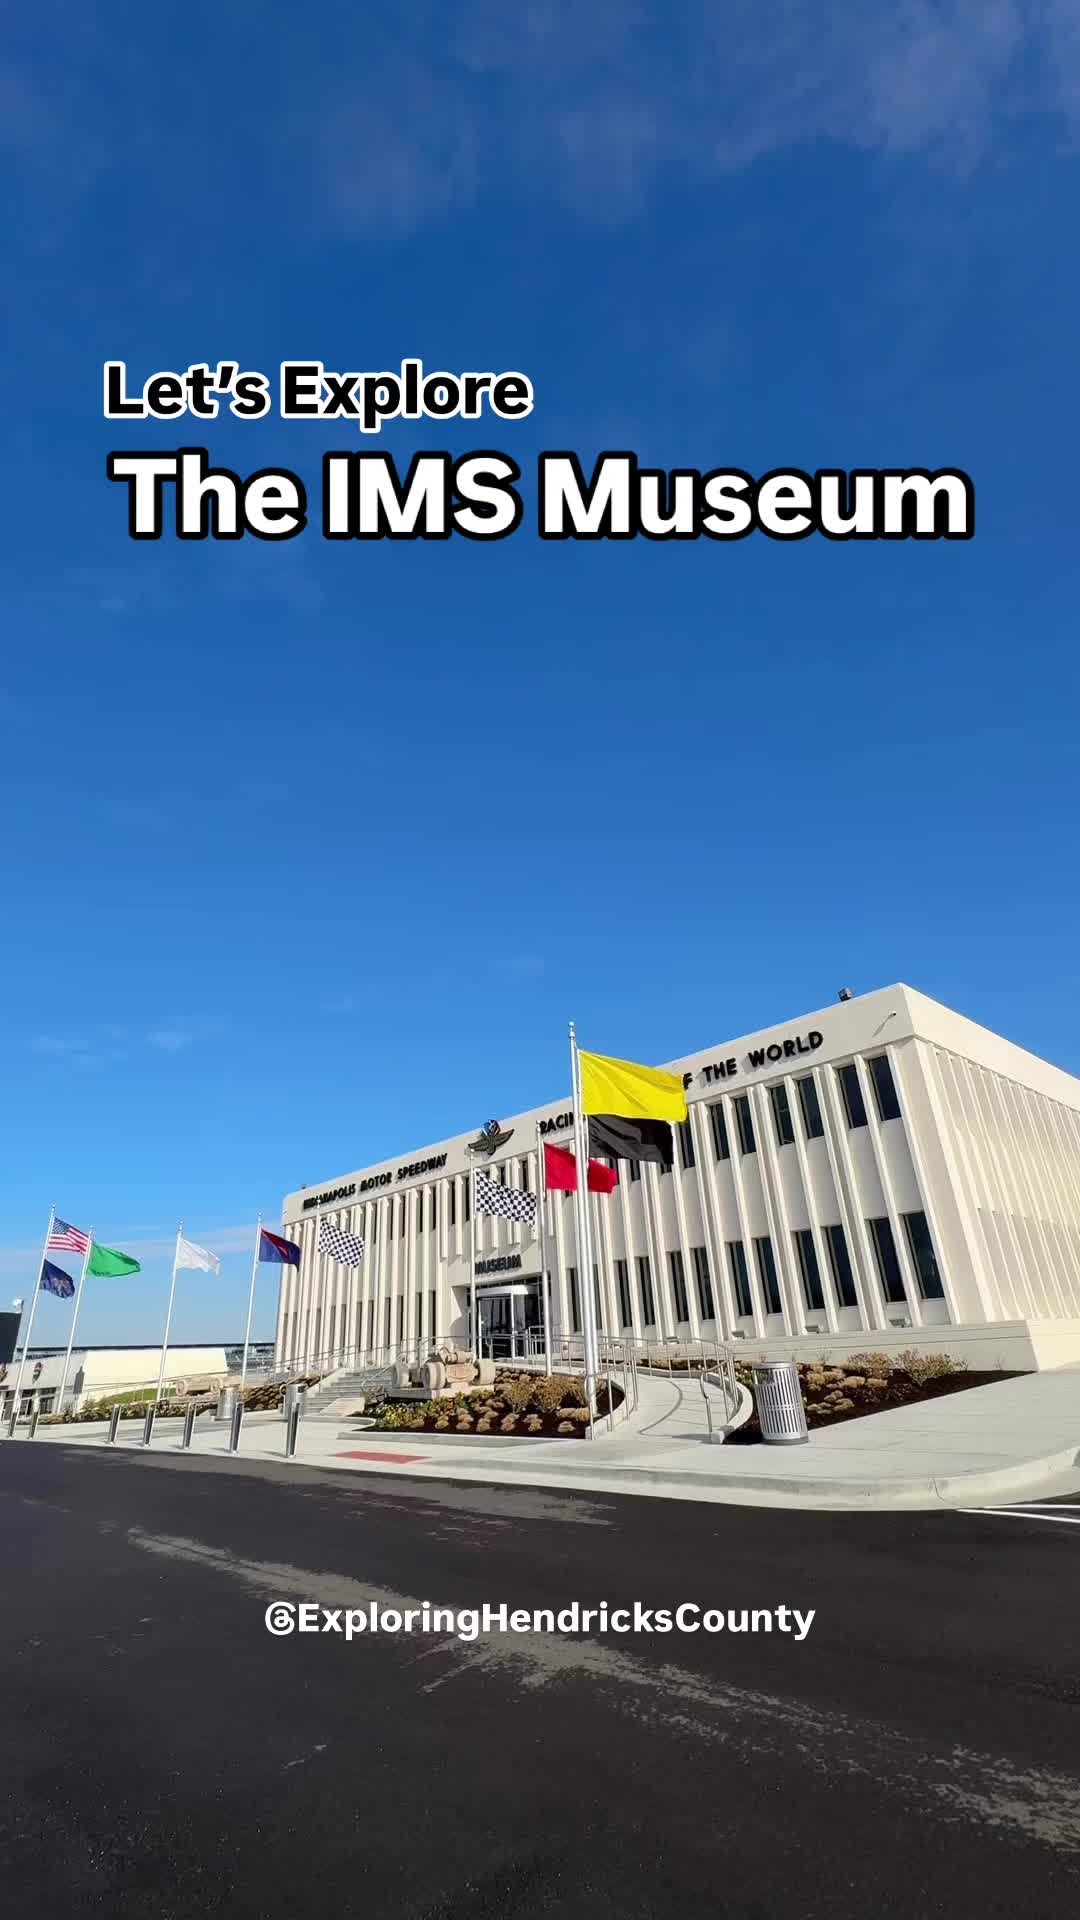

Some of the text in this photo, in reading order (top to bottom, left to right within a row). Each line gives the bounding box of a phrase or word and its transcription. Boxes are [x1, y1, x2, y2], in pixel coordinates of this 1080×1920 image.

[702, 1058, 738, 1082] THE
[748, 1031, 824, 1067] WORLD
[360, 1172, 392, 1192] MOTOR
[397, 1153, 448, 1179] SPEEDWAY
[475, 1254, 522, 1275] MUSEUM
